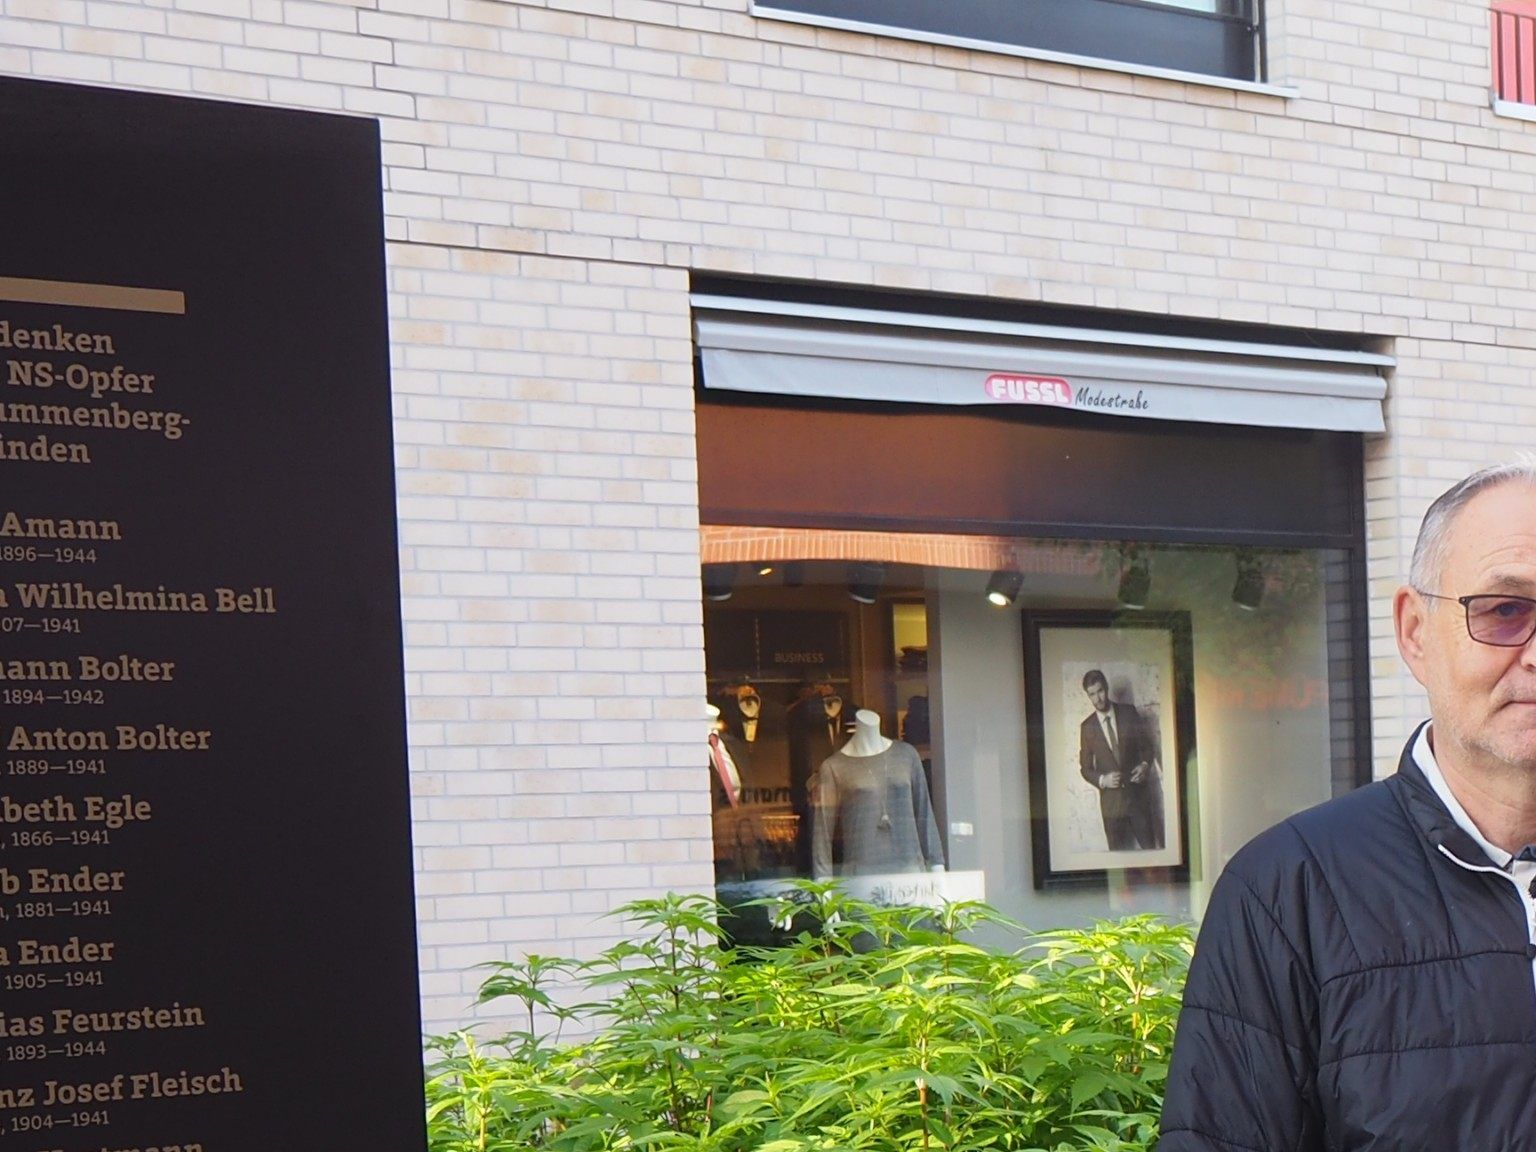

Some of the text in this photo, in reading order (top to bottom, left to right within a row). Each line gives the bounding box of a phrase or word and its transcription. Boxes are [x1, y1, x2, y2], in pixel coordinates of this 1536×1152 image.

[7, 360, 155, 398] NS-Opfer
[991, 379, 1069, 403] FUSSL
[0, 512, 121, 540] Amann
[15, 582, 209, 612] Wilhelmina
[215, 587, 277, 613] Bell
[79, 654, 175, 681] Bolter
[774, 652, 824, 663] BUSINESS
[7, 724, 211, 750] Anton Bolter
[0, 794, 151, 828] beth Egle
[28, 866, 125, 894] Ender
[18, 937, 114, 965] Ender
[52, 1002, 205, 1034] Feurstein
[43, 1074, 124, 1105] Josef
[130, 1067, 243, 1099] Fleisch
